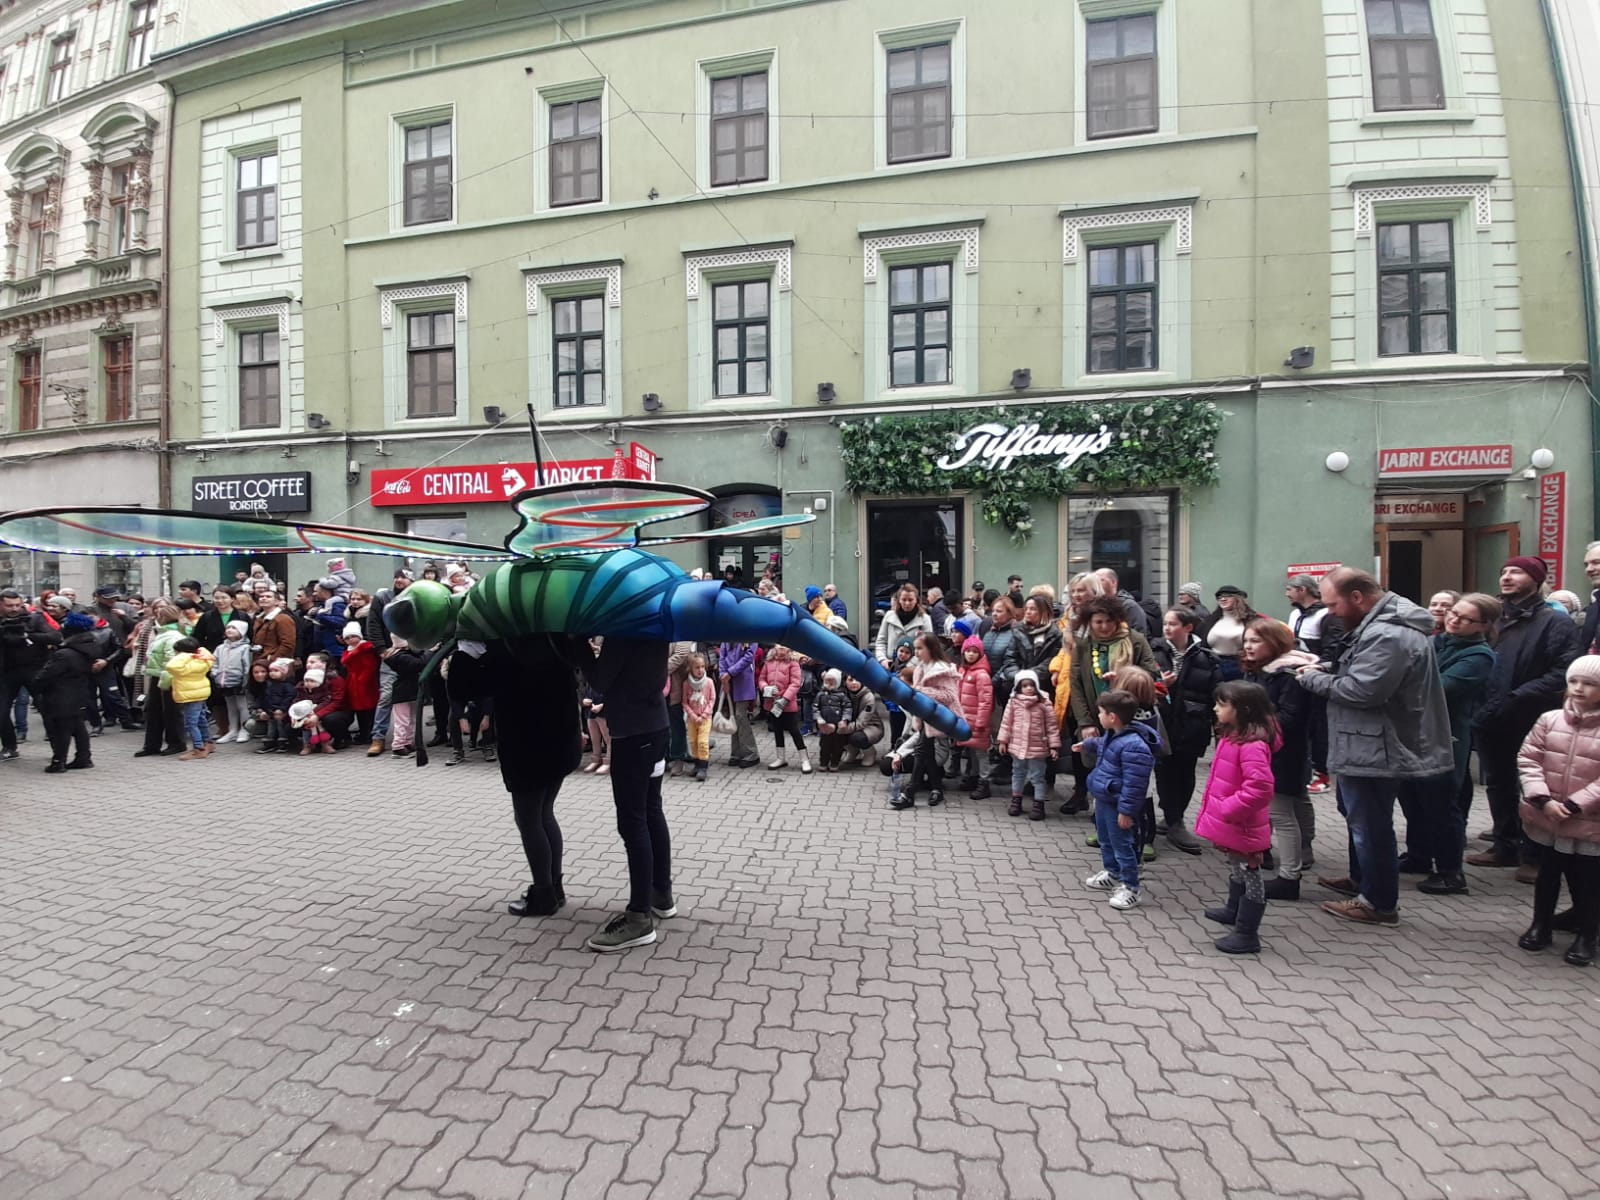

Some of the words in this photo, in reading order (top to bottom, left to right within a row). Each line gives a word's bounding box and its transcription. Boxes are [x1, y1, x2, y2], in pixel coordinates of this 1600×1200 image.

[937, 423, 1112, 470] Tiffany's
[1381, 452, 1425, 471] JABRI
[1429, 449, 1509, 467] EXCHANGE
[194, 481, 242, 500] STREET
[243, 478, 305, 498] COFFEE
[423, 471, 493, 496] CENTRAL
[229, 499, 268, 511] ROASTERS
[1394, 503, 1457, 515] EXCHANGE
[1542, 476, 1561, 553] EXCHANGE
